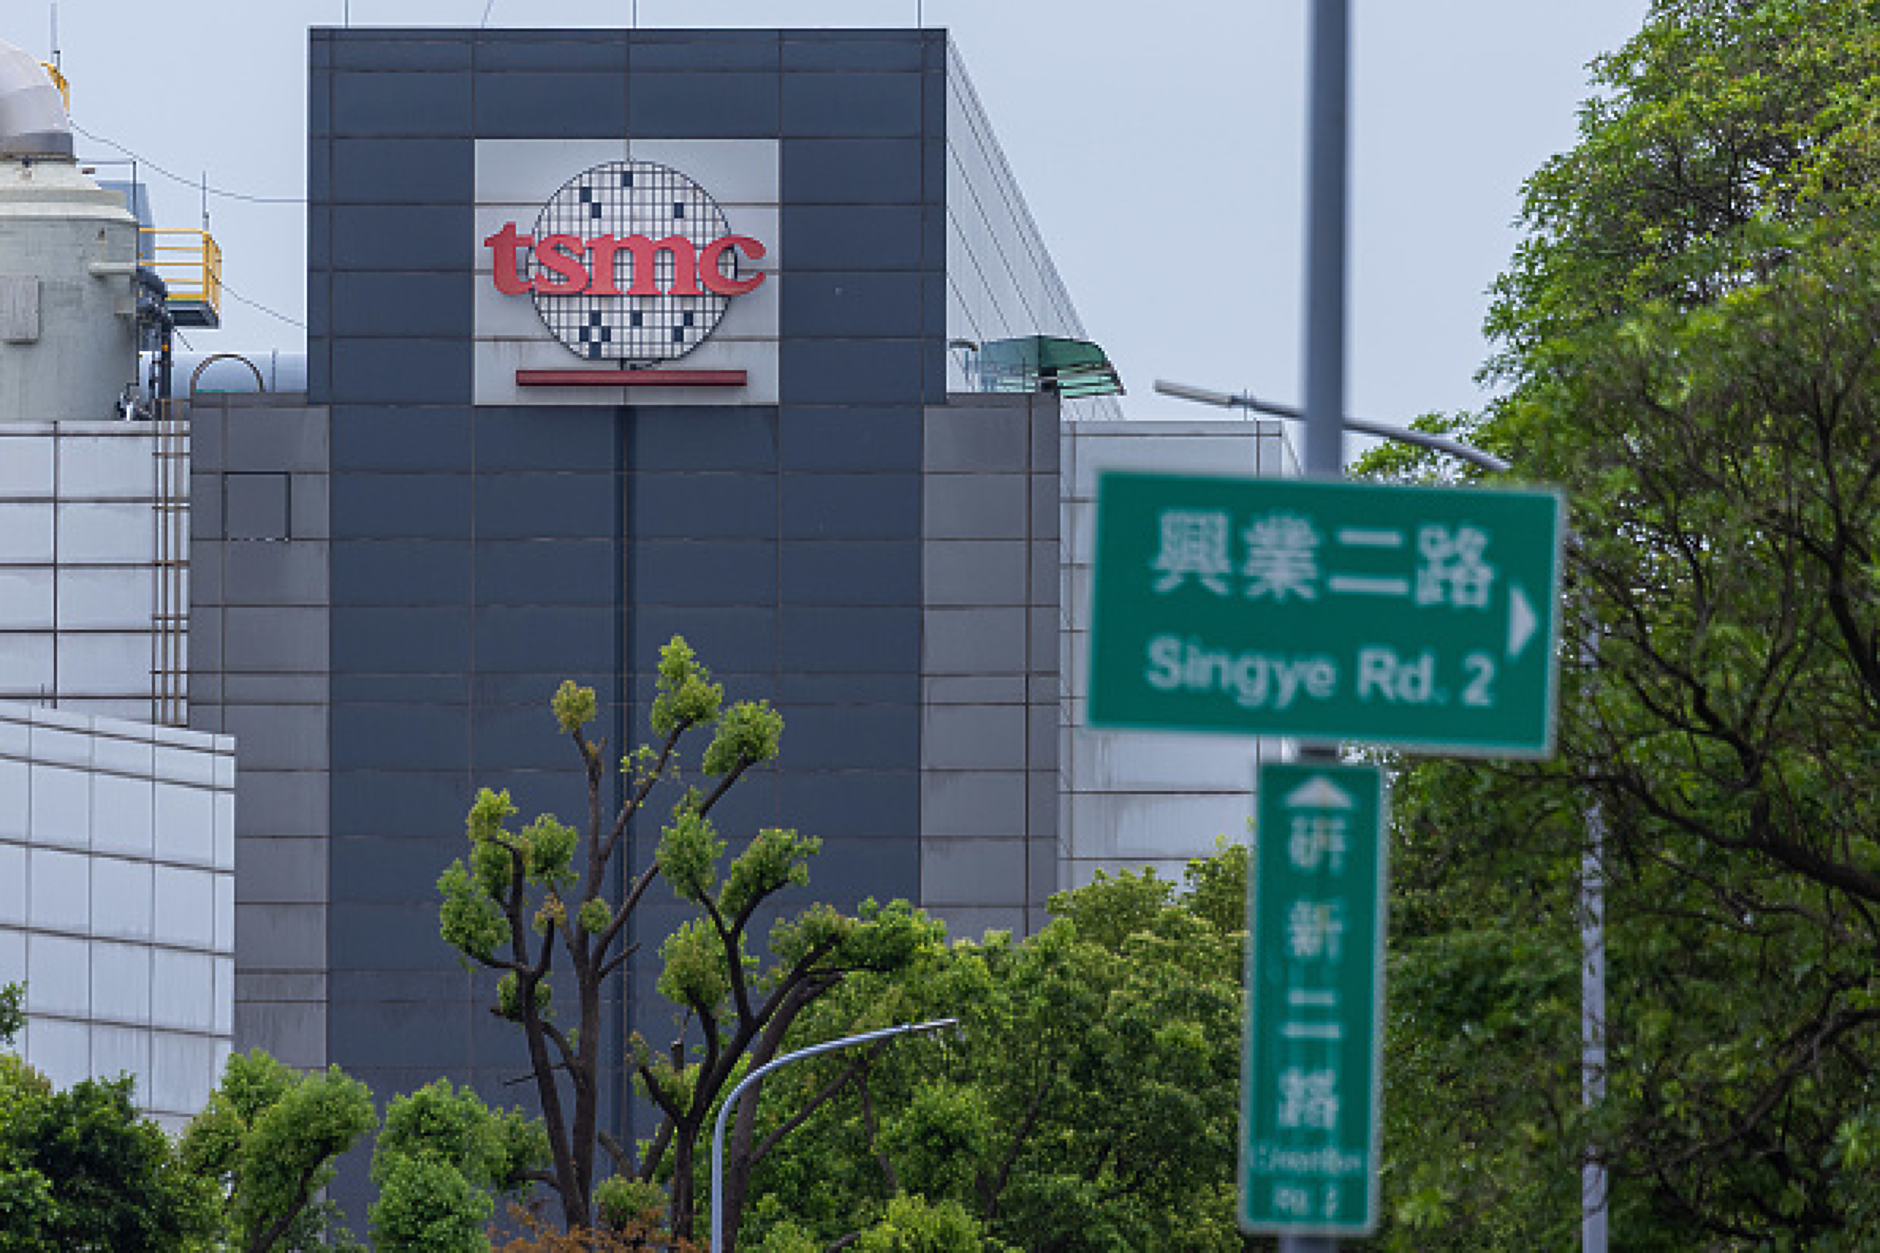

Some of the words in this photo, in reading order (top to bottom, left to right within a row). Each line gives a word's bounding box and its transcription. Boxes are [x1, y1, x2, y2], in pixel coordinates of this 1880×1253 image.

[484, 221, 766, 297] tsmc
[1152, 510, 1495, 608] 興業二路
[1146, 634, 1338, 708] Singye
[1356, 647, 1447, 703] Rd.
[1461, 653, 1496, 707] 2
